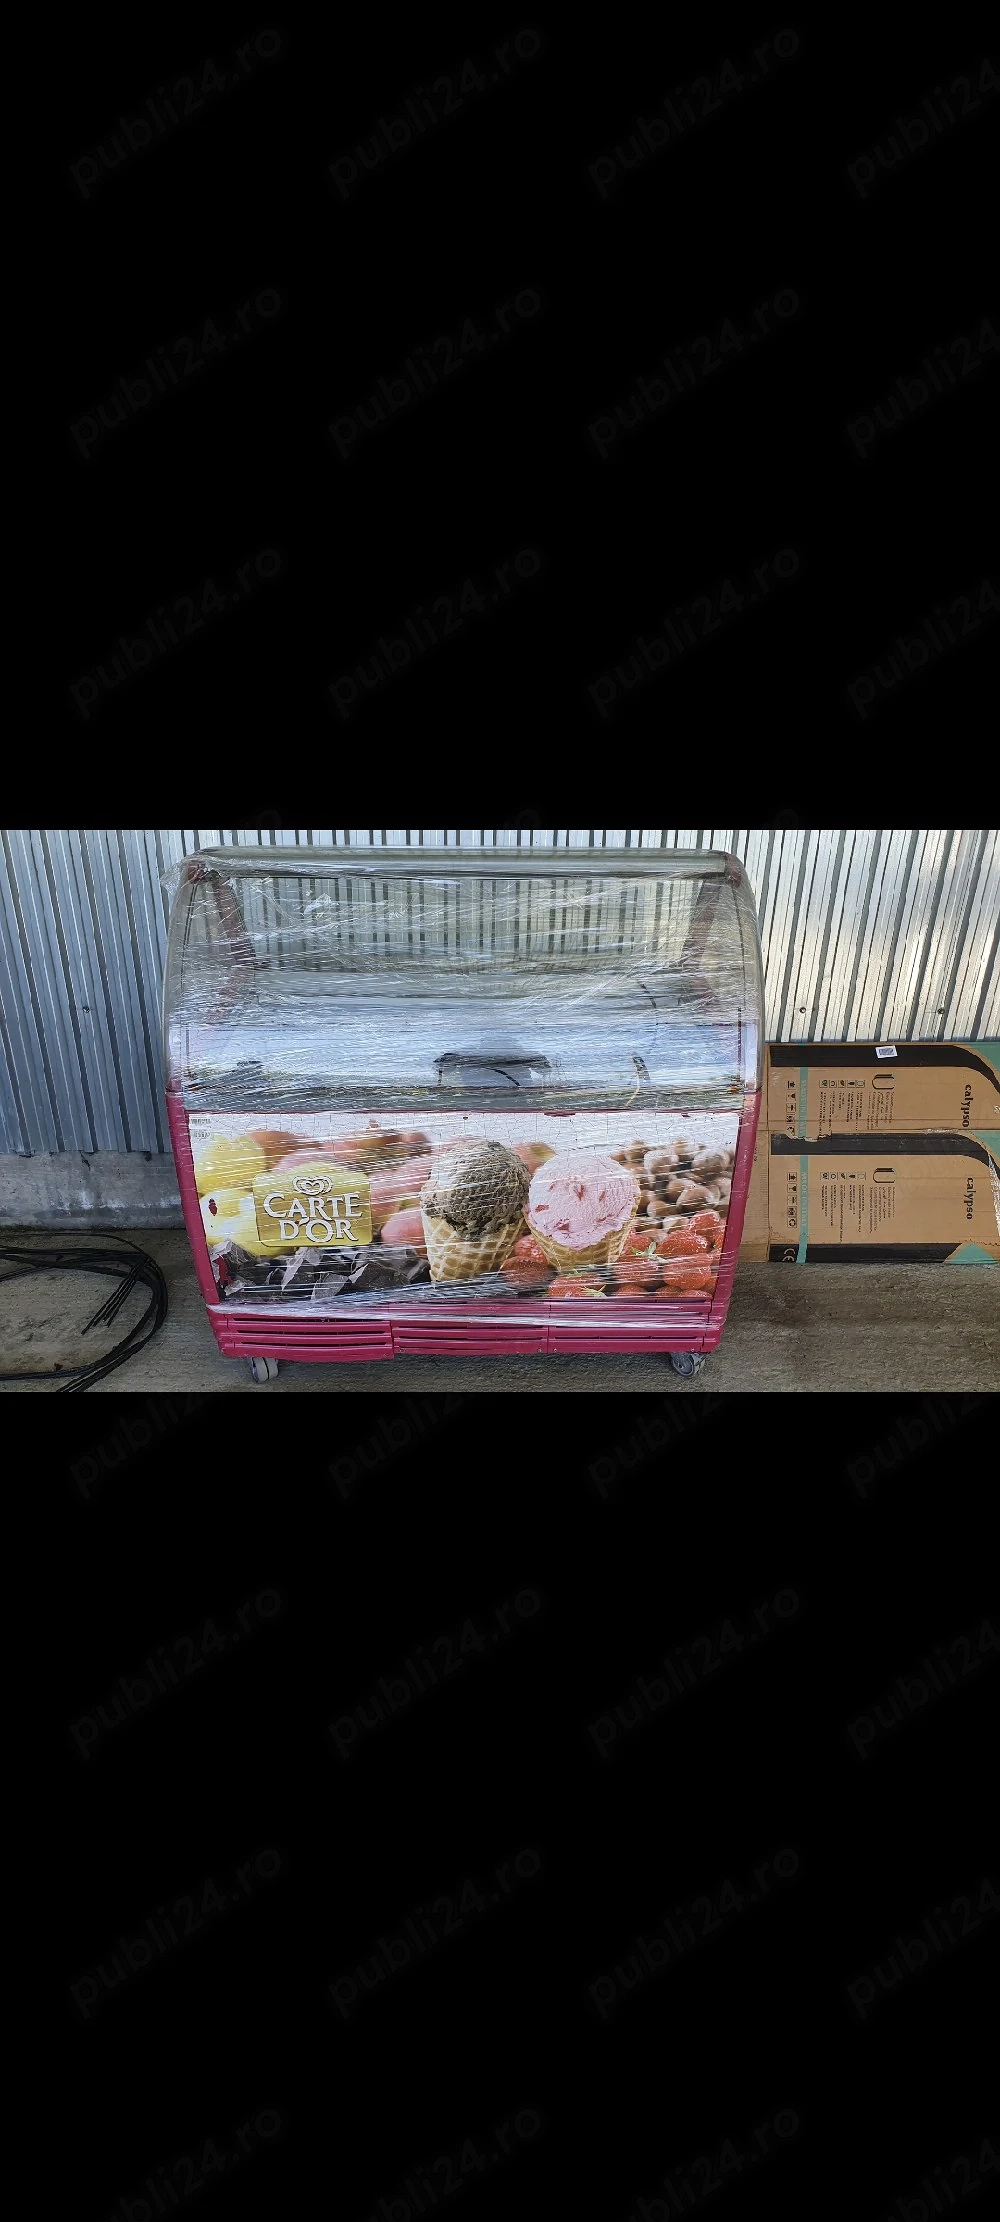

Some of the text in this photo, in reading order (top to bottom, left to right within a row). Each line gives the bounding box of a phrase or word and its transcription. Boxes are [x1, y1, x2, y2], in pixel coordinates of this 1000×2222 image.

[961, 1084, 974, 1128] calypso
[263, 1192, 363, 1221] CARTE
[964, 1177, 977, 1220] calypso
[279, 1217, 359, 1243] D'OR
